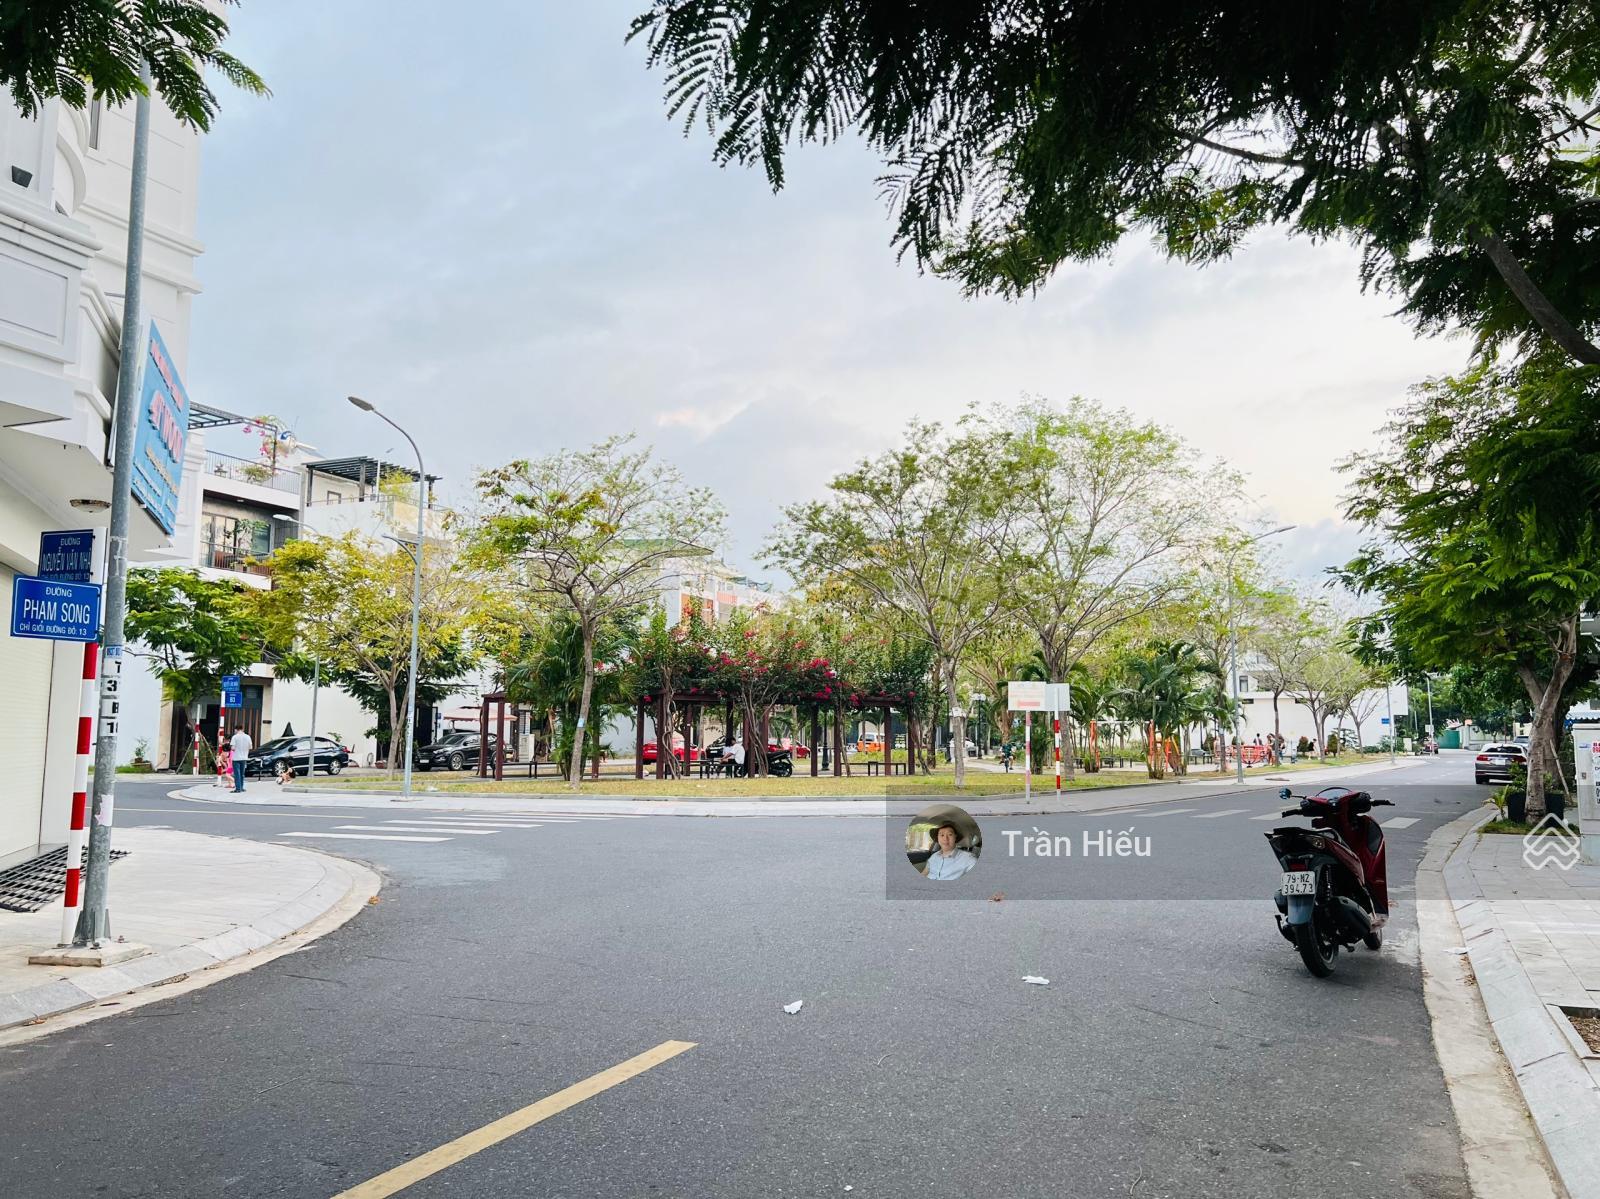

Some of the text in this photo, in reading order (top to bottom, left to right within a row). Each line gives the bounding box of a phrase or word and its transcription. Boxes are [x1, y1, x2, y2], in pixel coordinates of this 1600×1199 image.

[45, 586, 72, 598] ĐƯỜNG
[23, 599, 91, 625] PHẠM SONG
[79, 628, 87, 636] 13
[1284, 884, 1314, 894] 394.73
